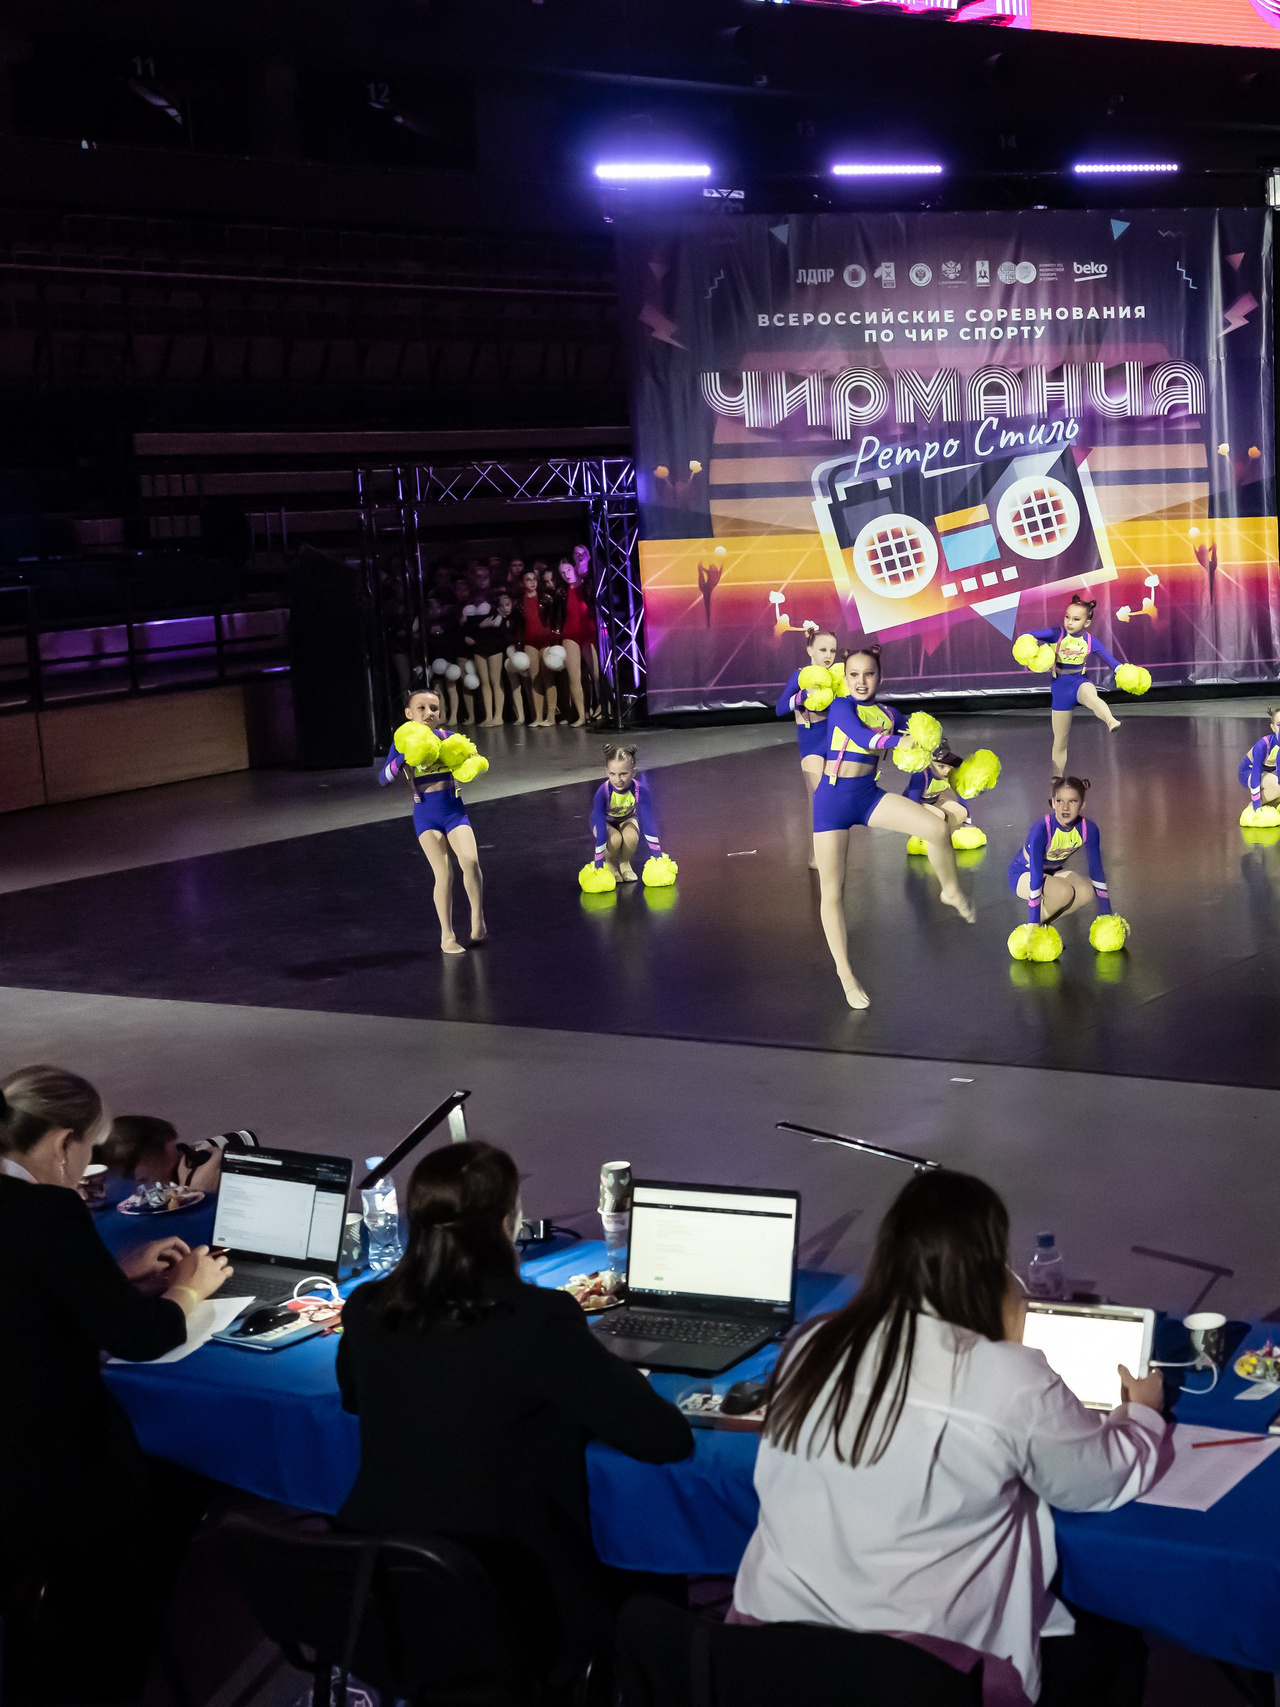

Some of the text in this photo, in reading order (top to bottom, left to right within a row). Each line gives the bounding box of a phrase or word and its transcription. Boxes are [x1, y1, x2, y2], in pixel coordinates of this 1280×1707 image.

[796, 268, 835, 285] ЛДПР
[1073, 261, 1109, 274] beko
[757, 305, 1146, 327] ВСЕРОССИЙСКИЕ СОРЕВНОВАНИЯ
[864, 325, 1046, 343] ПО ЧИР СПОРТУ
[853, 415, 1080, 478] Ретро Стиль
